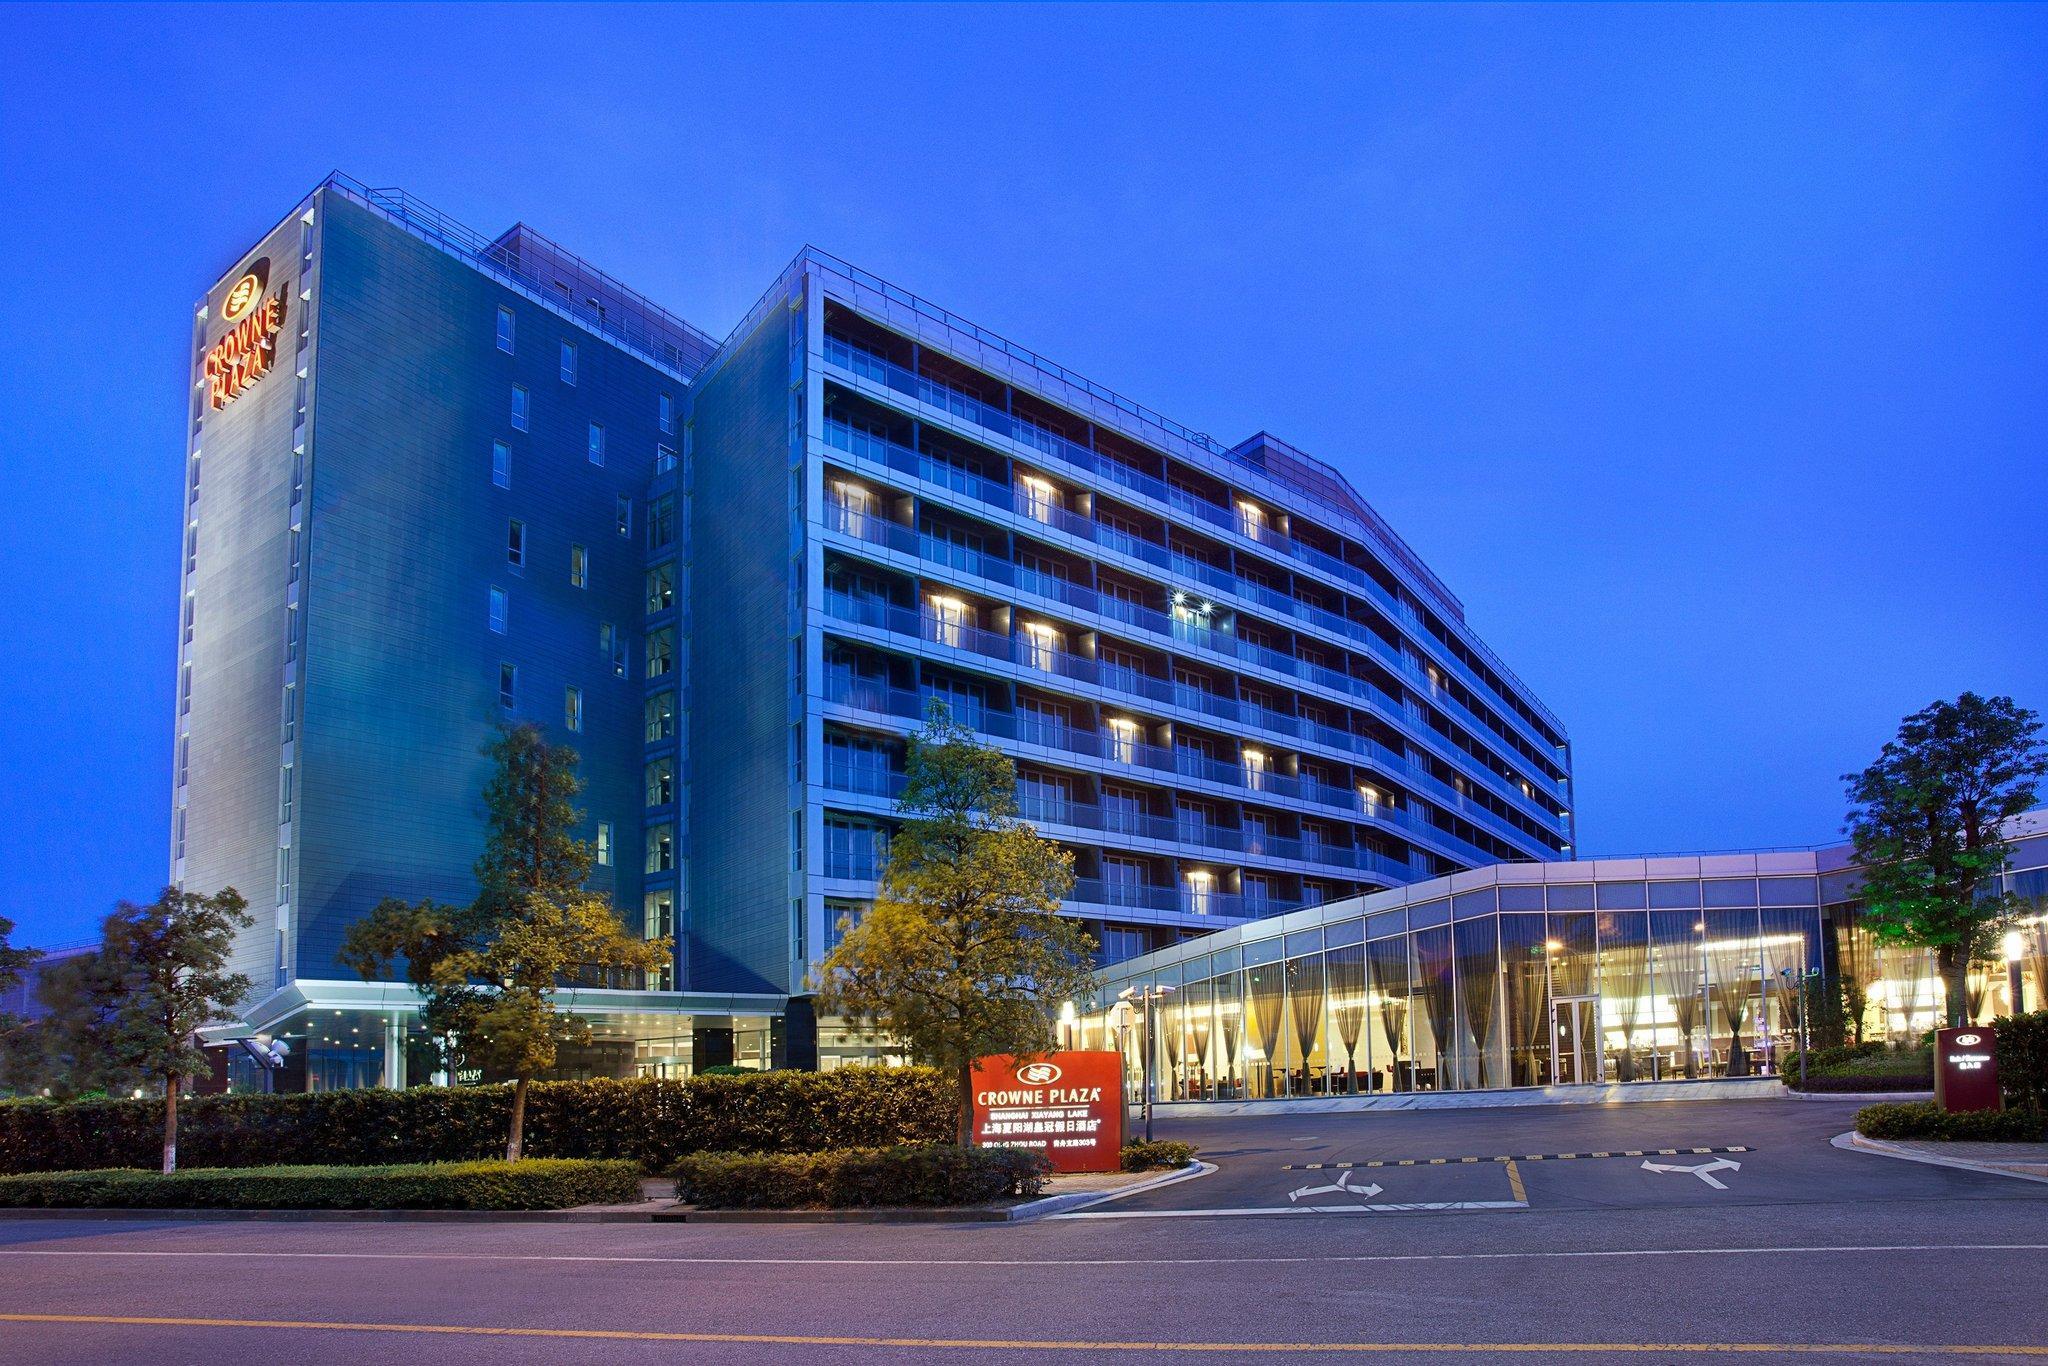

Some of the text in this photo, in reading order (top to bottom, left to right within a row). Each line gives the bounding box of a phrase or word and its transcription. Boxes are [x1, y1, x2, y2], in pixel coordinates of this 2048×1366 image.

[204, 296, 282, 381] CROWNE
[210, 343, 271, 411] PLAZA
[977, 1088, 1100, 1106] CROWNE PLAZA
[990, 1111, 1029, 1120] SHANGHAI
[1067, 1110, 1088, 1118] LAKE
